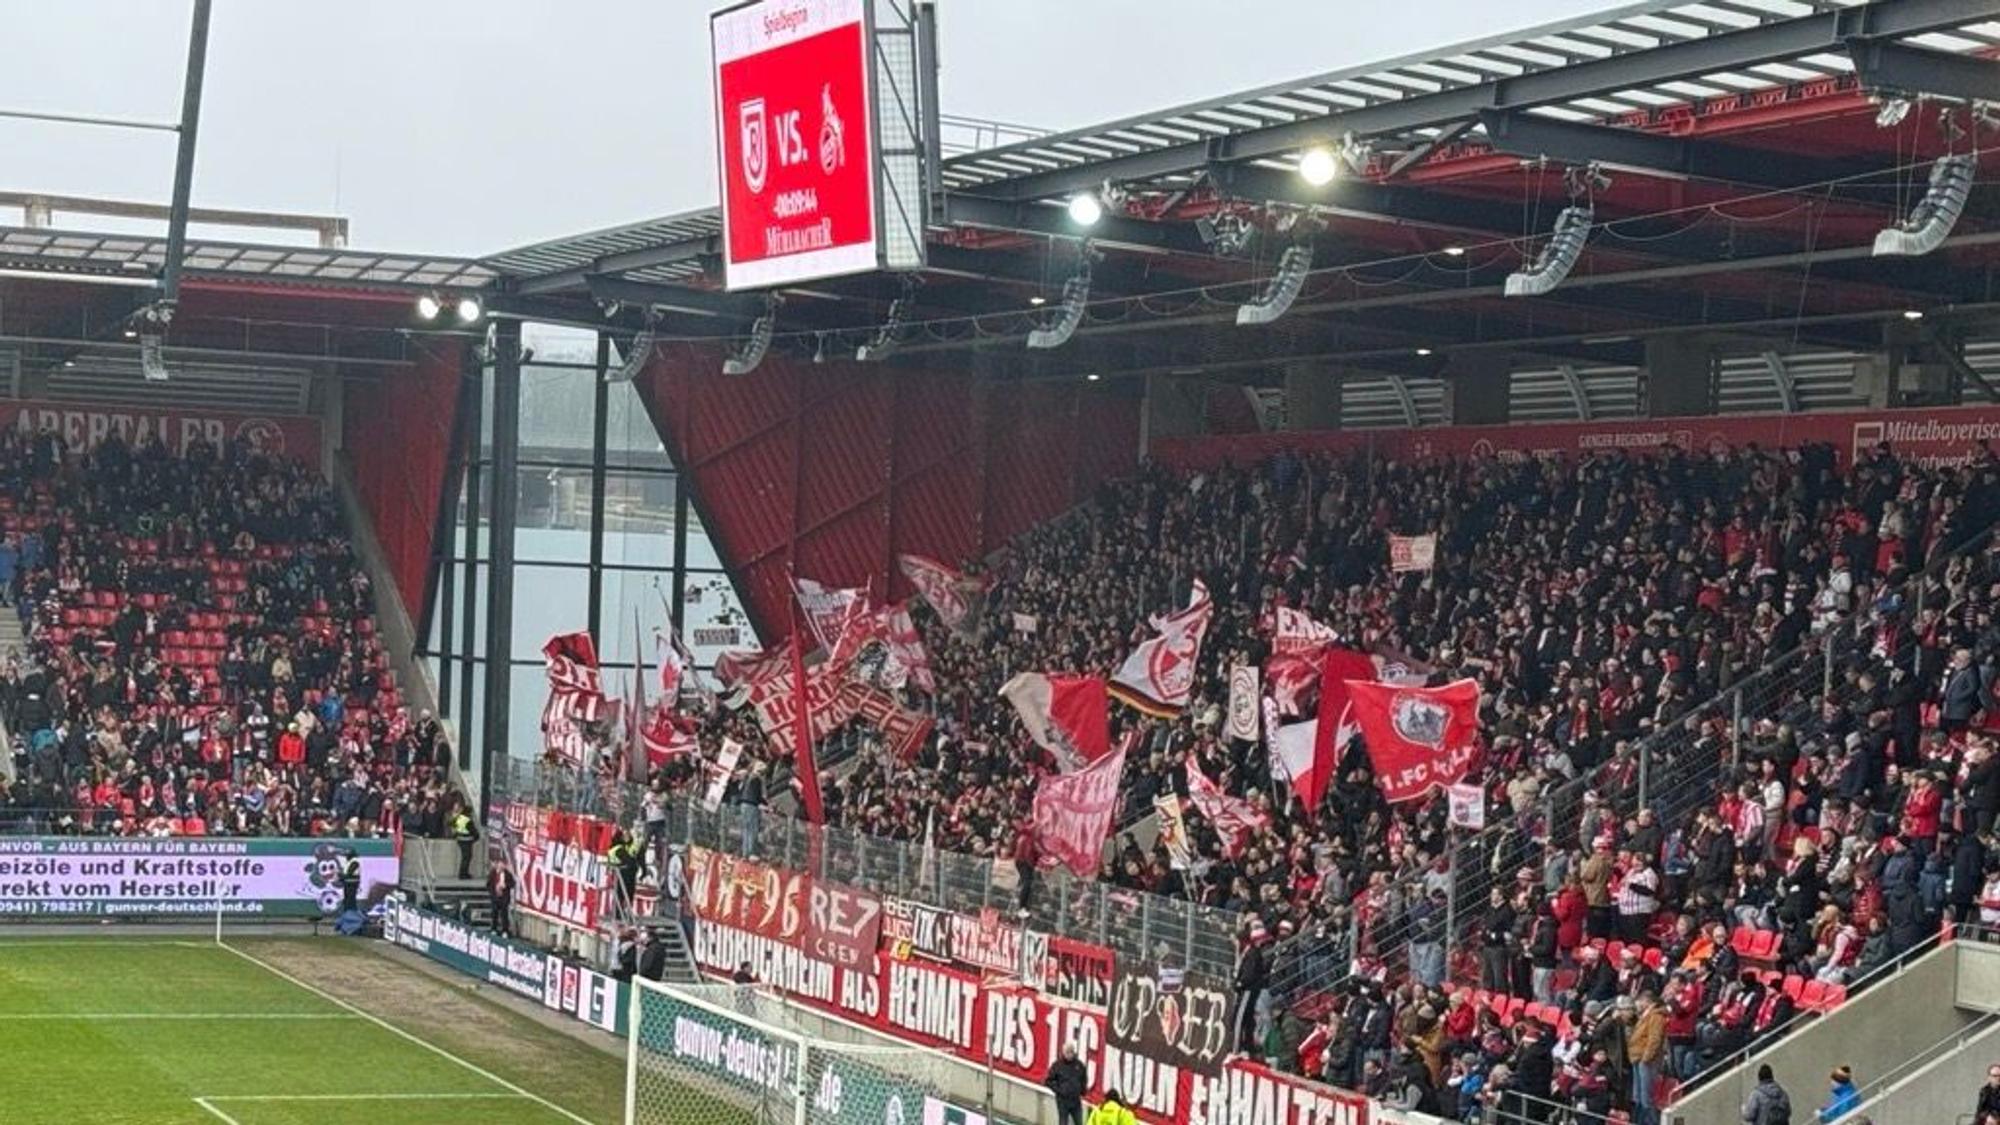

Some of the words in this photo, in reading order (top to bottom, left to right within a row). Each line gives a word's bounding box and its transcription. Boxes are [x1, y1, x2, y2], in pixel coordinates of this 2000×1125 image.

[775, 109, 809, 166] VS.
[58, 841, 90, 853] AUS
[93, 841, 152, 853] BAYERN
[156, 840, 186, 854] FÜR
[189, 842, 248, 854] BAYERN
[0, 857, 72, 876] eizöle
[80, 858, 125, 876] und
[133, 858, 266, 877] Kraftstoffe
[2, 880, 51, 896] rekt
[60, 883, 111, 896] vom
[889, 960, 978, 1050] HEIMAT
[985, 989, 1037, 1068] DES
